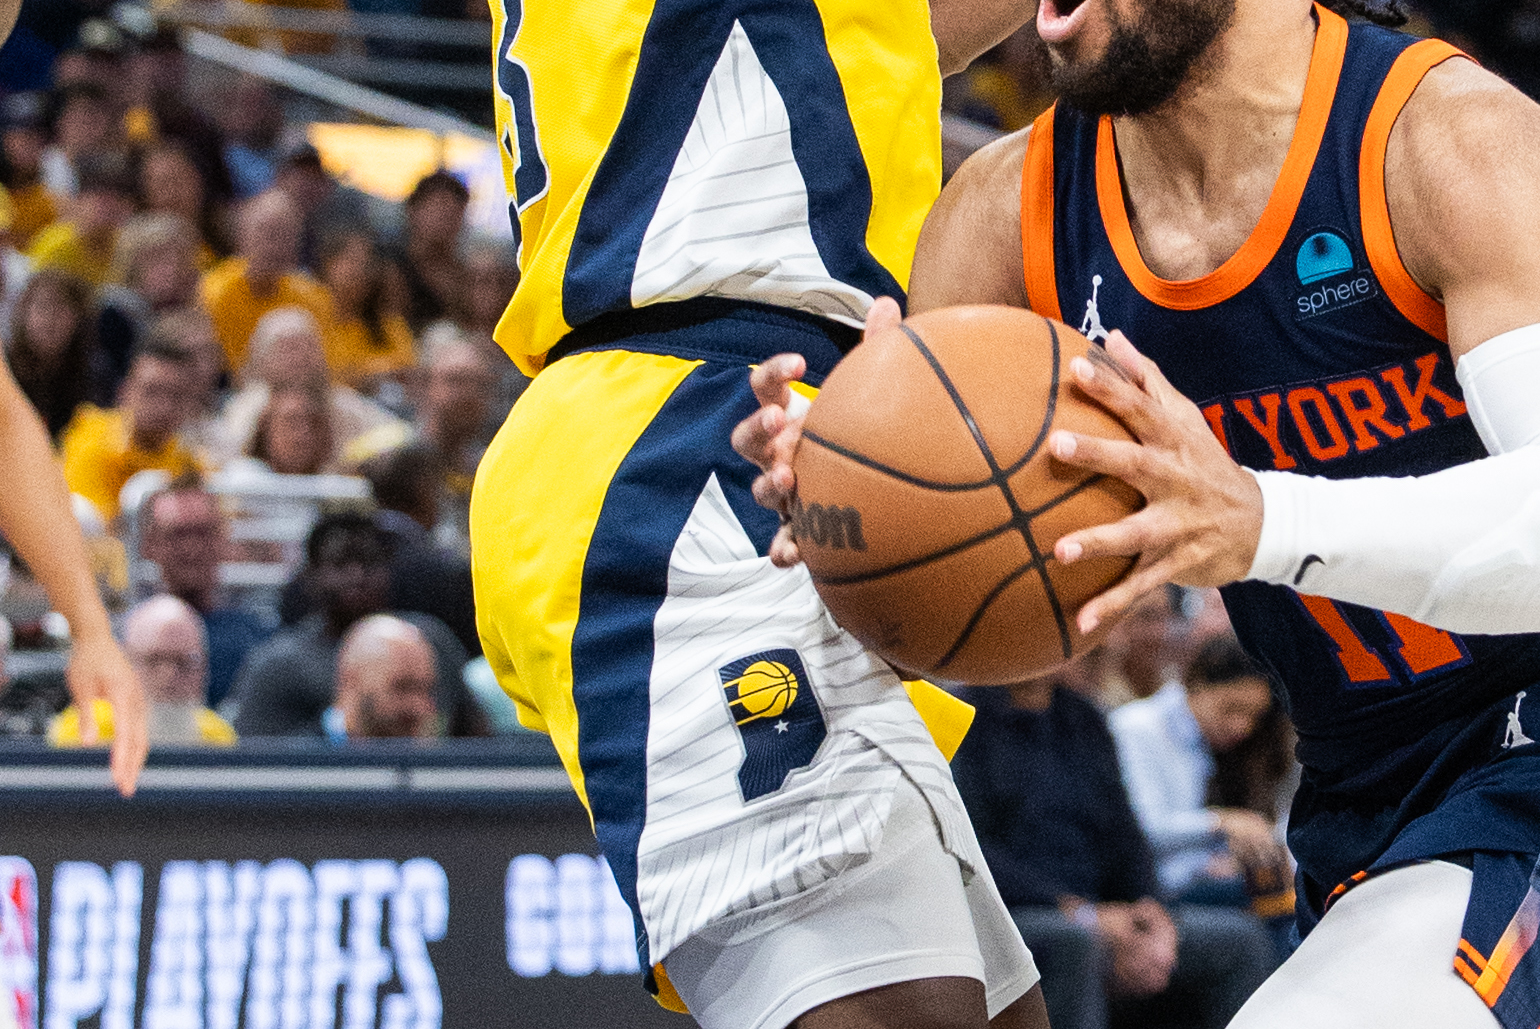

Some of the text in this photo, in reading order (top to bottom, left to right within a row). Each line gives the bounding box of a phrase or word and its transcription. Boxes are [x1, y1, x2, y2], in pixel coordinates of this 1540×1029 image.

[1297, 277, 1370, 314] sphere
[1232, 352, 1468, 470] YORK
[42, 855, 450, 1029] PLAYOFFS
